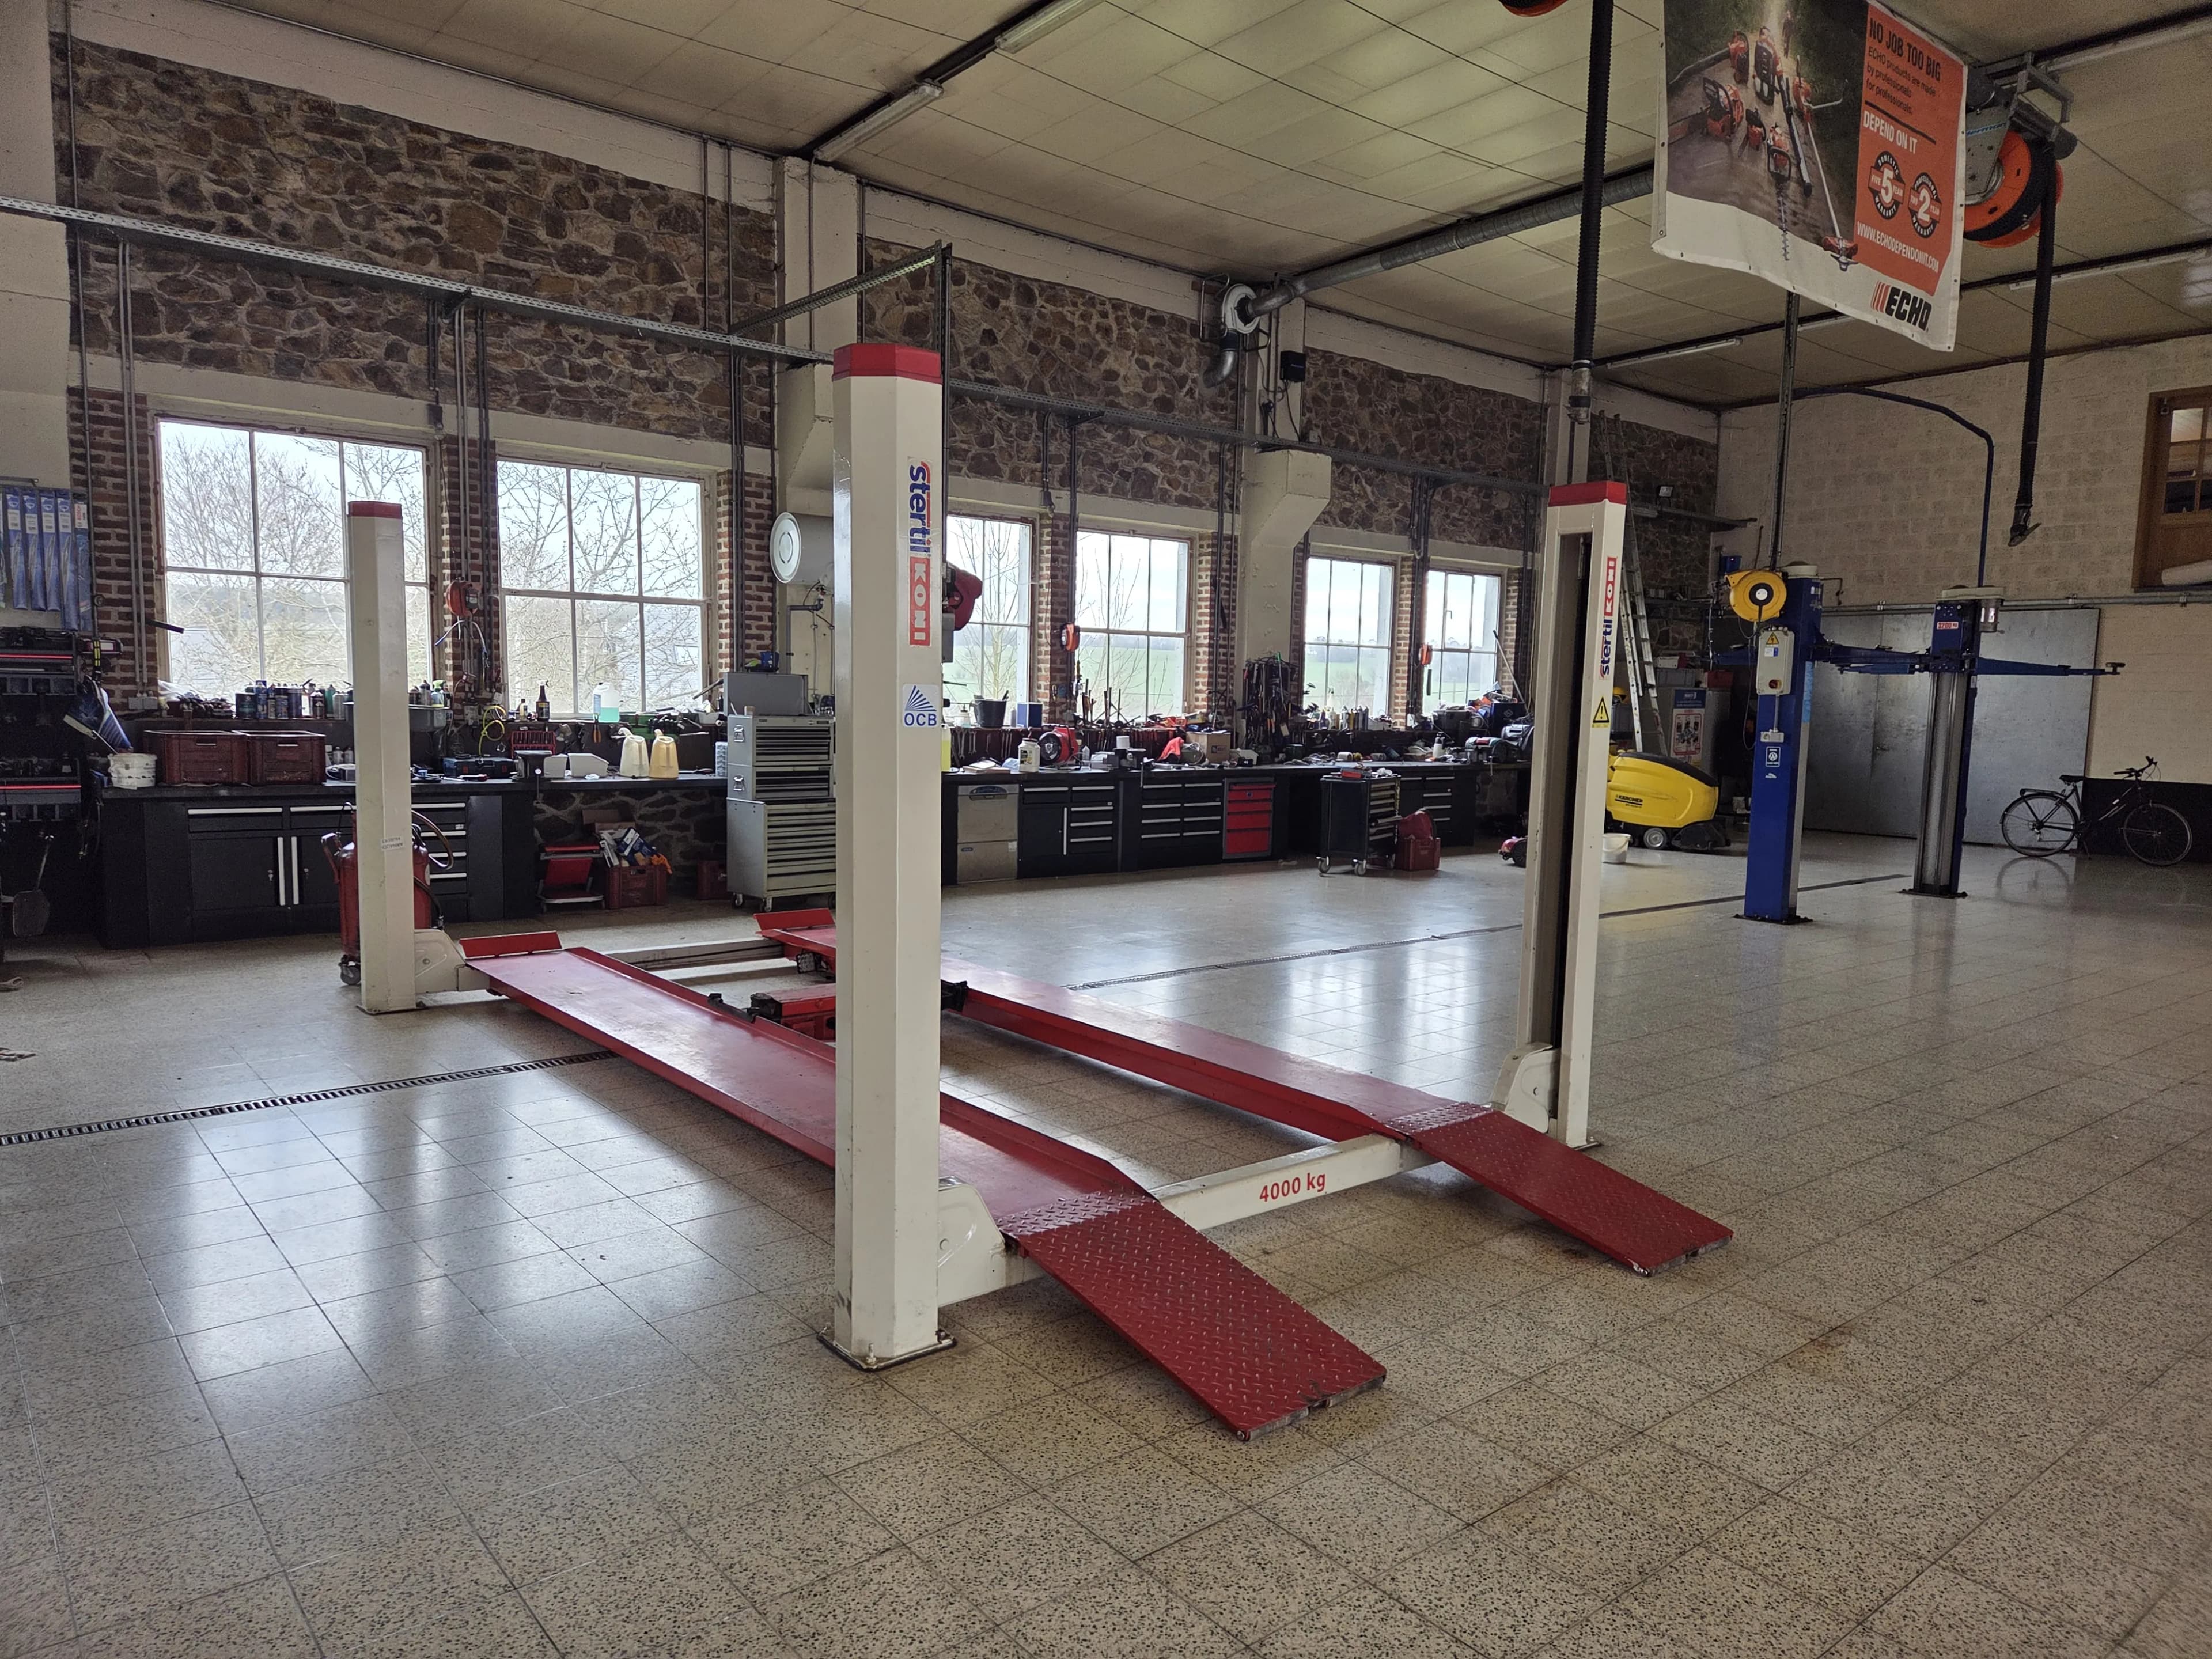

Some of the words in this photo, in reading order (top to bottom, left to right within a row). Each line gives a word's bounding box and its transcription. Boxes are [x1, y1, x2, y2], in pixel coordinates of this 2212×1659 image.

[1868, 46, 1886, 65] ECHO
[1869, 18, 1883, 44] NO
[1885, 30, 1903, 58] JOB
[1907, 42, 1924, 70] TOO
[1926, 55, 1941, 82] BIG
[1866, 78, 1876, 91] for
[1867, 62, 1874, 77] by
[1863, 110, 1895, 142] DEPEND
[1896, 130, 1908, 149] ON
[1910, 136, 1918, 154] IT
[1881, 167, 1894, 204] 5
[1918, 188, 1931, 222] 2
[1857, 221, 1940, 274] WWW.ECHODEPENDONIT.COM
[1885, 286, 1933, 332] ECHO
[913, 562, 928, 642] KONI
[1605, 560, 1616, 613] KONI
[903, 712, 938, 727] OCB
[1259, 1177, 1301, 1202] 4000
[1306, 1172, 1326, 1193] kg
